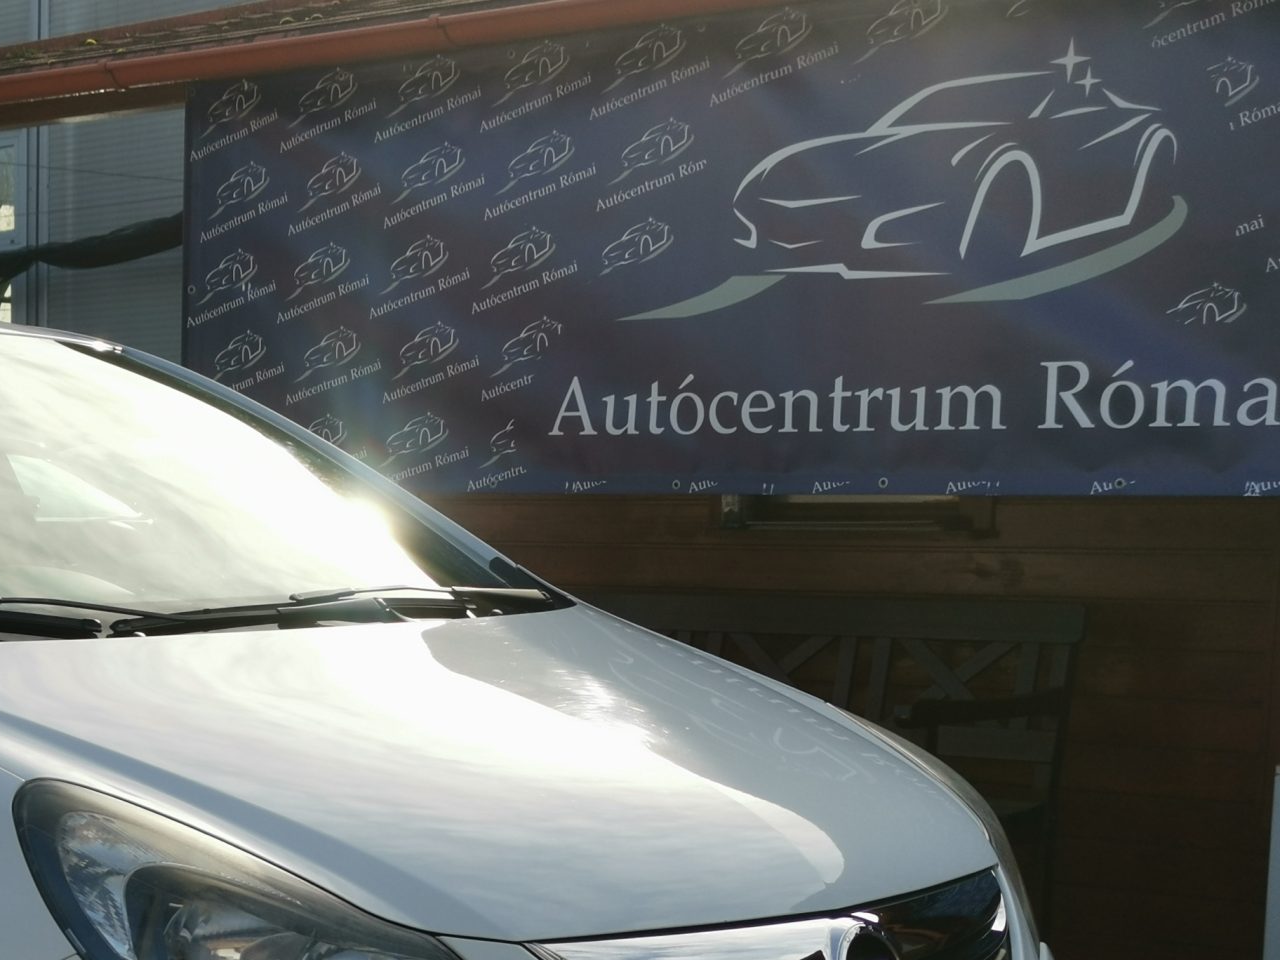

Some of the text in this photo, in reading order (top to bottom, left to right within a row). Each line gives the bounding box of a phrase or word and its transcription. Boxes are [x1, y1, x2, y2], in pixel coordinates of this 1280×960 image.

[589, 56, 711, 121] Autócentrum Római
[709, 41, 840, 107] Autócentrum Római
[279, 99, 377, 153] Autócentrum Római
[374, 86, 482, 144] Autócentrum Római
[479, 72, 593, 133] Autócentrum Római
[199, 191, 289, 244] Autócentrum Római
[287, 183, 383, 237] Autócentrum Római
[382, 172, 486, 230] Autócentrum Római
[483, 161, 597, 221] Autócentrum Római
[596, 172, 676, 213] Autócentrum
[186, 280, 277, 328] Autócentrum Római
[276, 274, 371, 325] Autócentrum Római
[369, 267, 471, 320] Autócentrum Római
[471, 260, 579, 315] Autócentrum Római
[255, 361, 286, 382] Római
[285, 358, 382, 406] Autócentrum Római
[382, 354, 481, 405] Autócentrum Római
[548, 359, 1280, 436] Autócentrum Róma
[435, 446, 470, 469] Római
